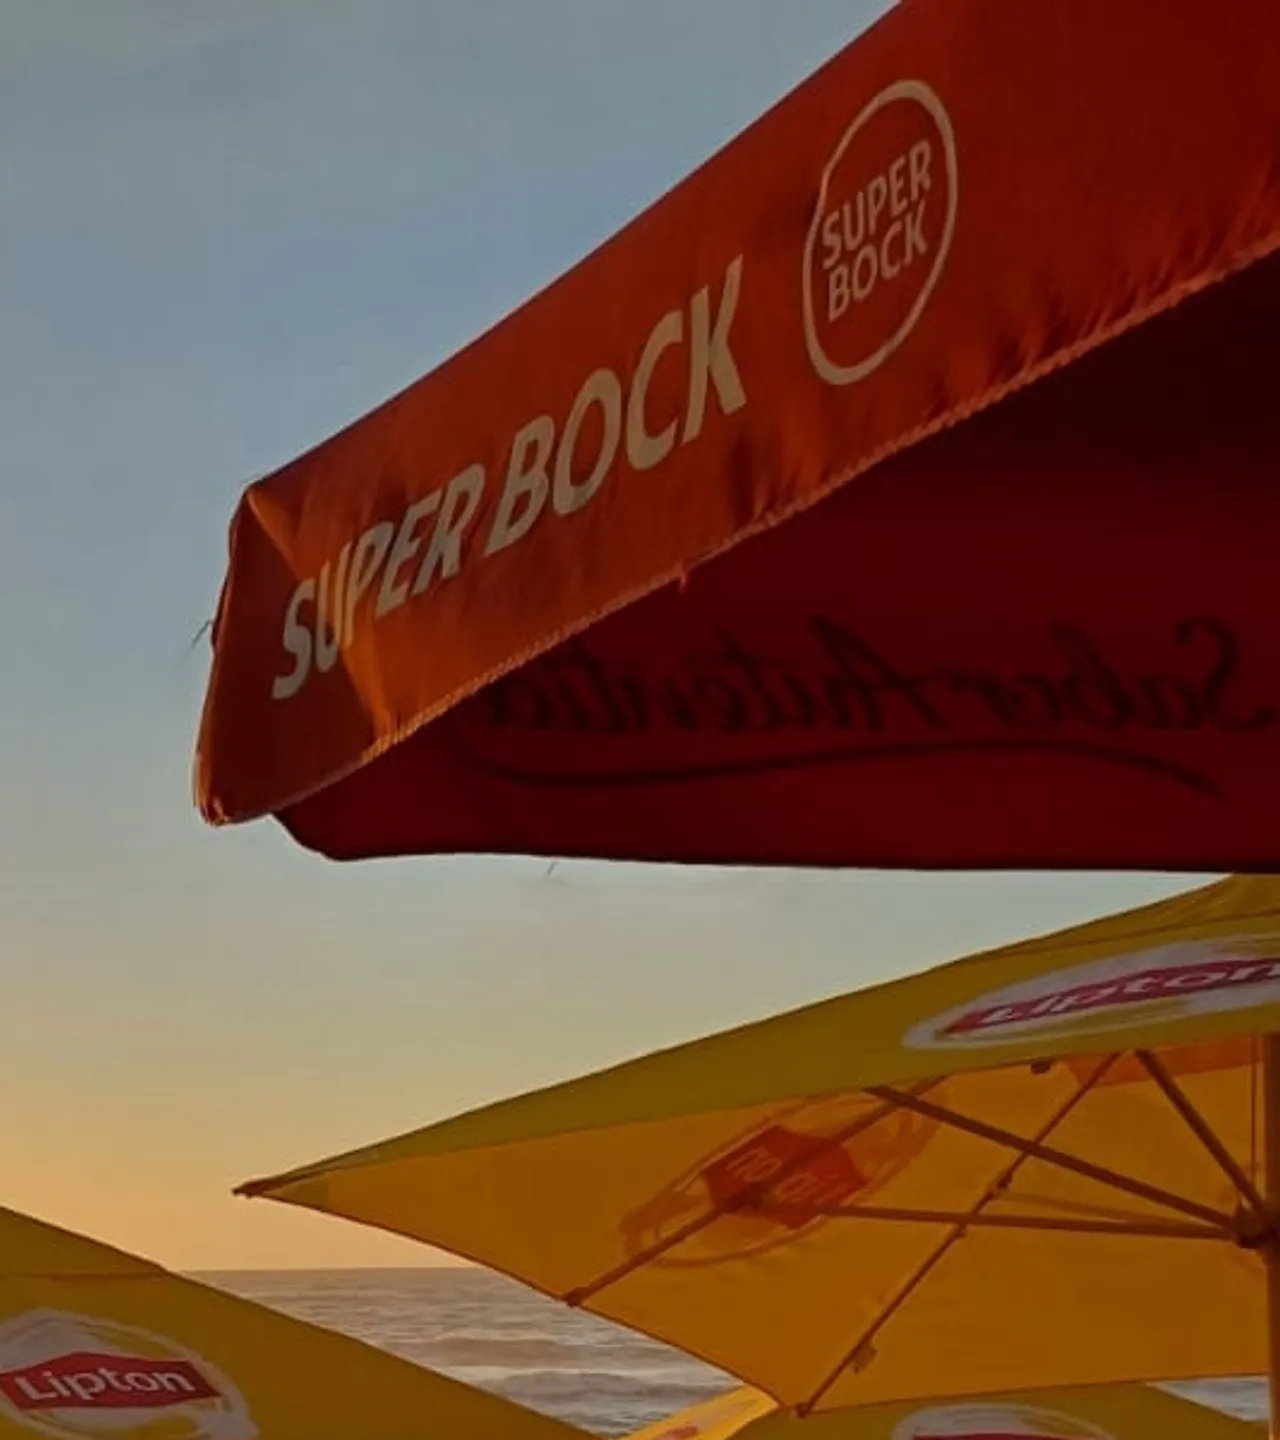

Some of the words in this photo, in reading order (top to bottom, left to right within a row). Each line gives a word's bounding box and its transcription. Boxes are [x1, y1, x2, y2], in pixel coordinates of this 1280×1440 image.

[822, 138, 931, 270] SUPER
[828, 197, 927, 324] BOCK
[271, 462, 487, 700] SUPER
[483, 254, 748, 557] BOCK
[13, 1366, 197, 1401] Lipton
